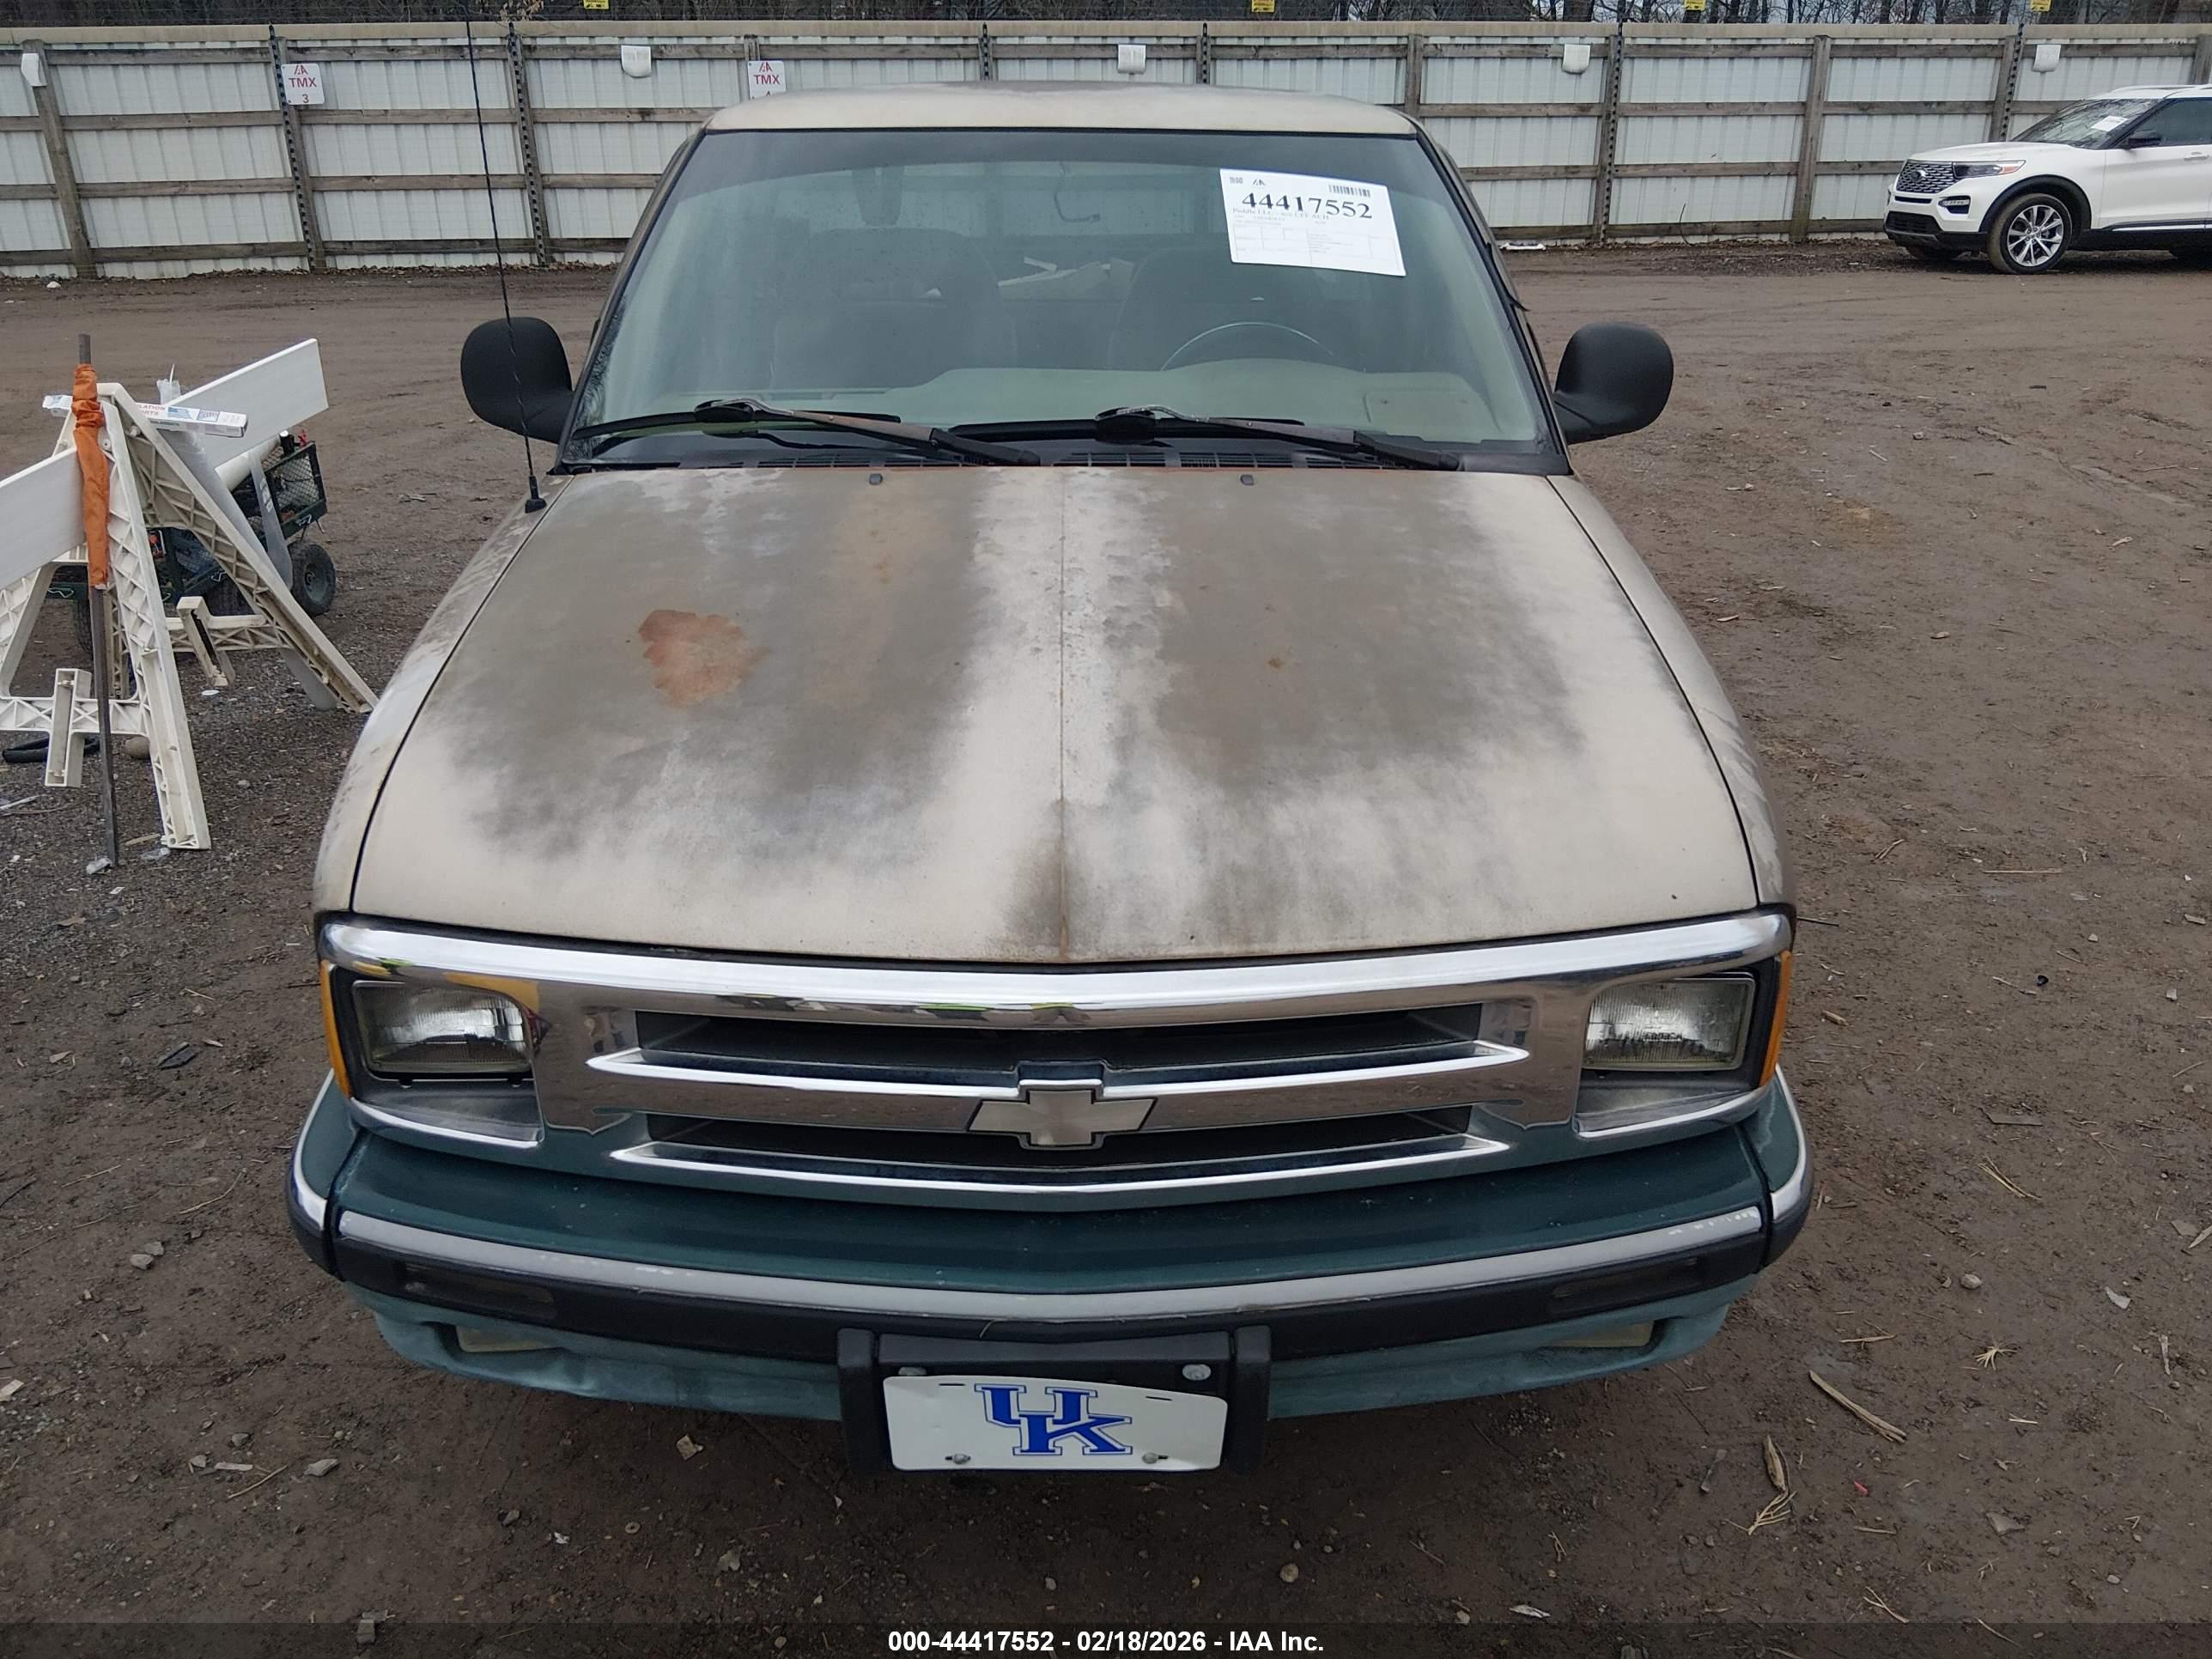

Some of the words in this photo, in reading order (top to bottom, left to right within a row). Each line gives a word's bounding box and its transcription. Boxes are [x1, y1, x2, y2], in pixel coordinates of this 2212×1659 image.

[289, 77, 317, 88] TMX
[753, 75, 780, 84] TMX
[302, 94, 309, 103] 3
[1242, 192, 1372, 219] 44417552
[974, 1383, 1133, 1455] UK
